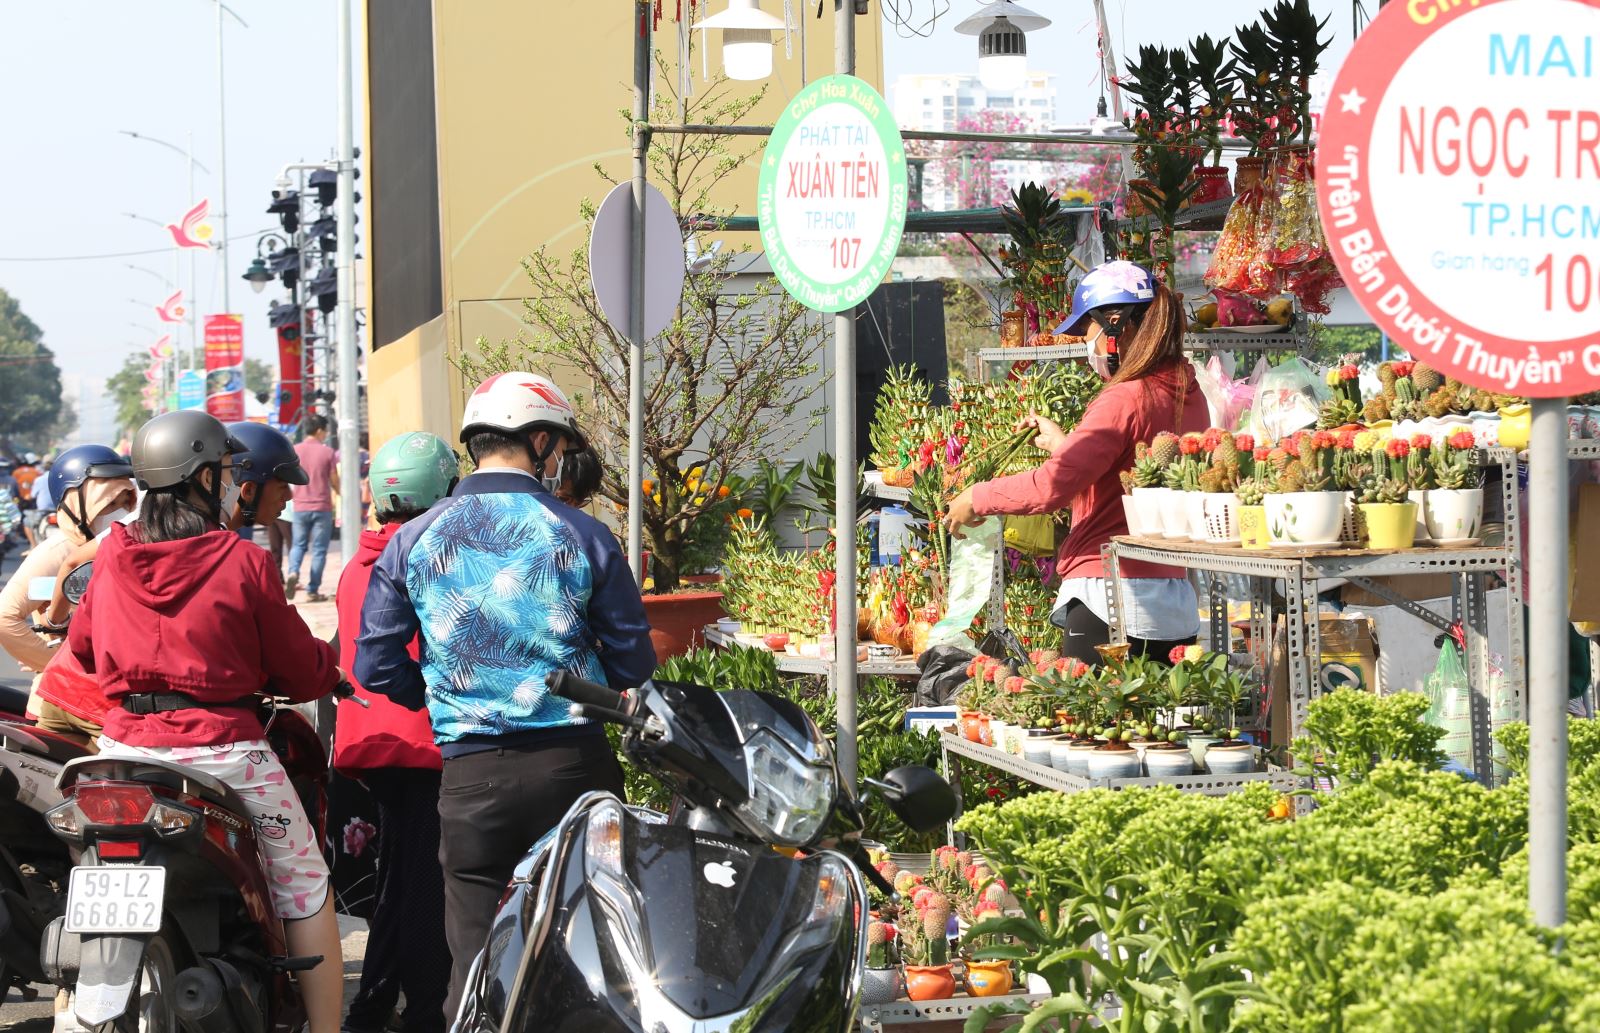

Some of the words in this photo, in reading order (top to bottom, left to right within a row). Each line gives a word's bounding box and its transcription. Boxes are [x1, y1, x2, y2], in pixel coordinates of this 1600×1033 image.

[1489, 33, 1592, 78] MAI
[791, 91, 818, 119] Chợ
[849, 83, 881, 119] Xuân
[1398, 105, 1529, 195] NGỌC
[787, 152, 835, 198] XUÂN
[841, 152, 879, 198] TIÊN
[806, 212, 855, 230] TP.HCM
[891, 184, 904, 223] 2023
[1461, 201, 1600, 240] TP.HCM
[830, 238, 861, 269] 107
[1340, 228, 1387, 294] Bến
[1376, 284, 1451, 353] Dưới
[1535, 253, 1600, 313] 10
[19, 760, 58, 779] VISIO
[84, 872, 150, 898] 59-L2
[73, 902, 156, 928] 668.62
